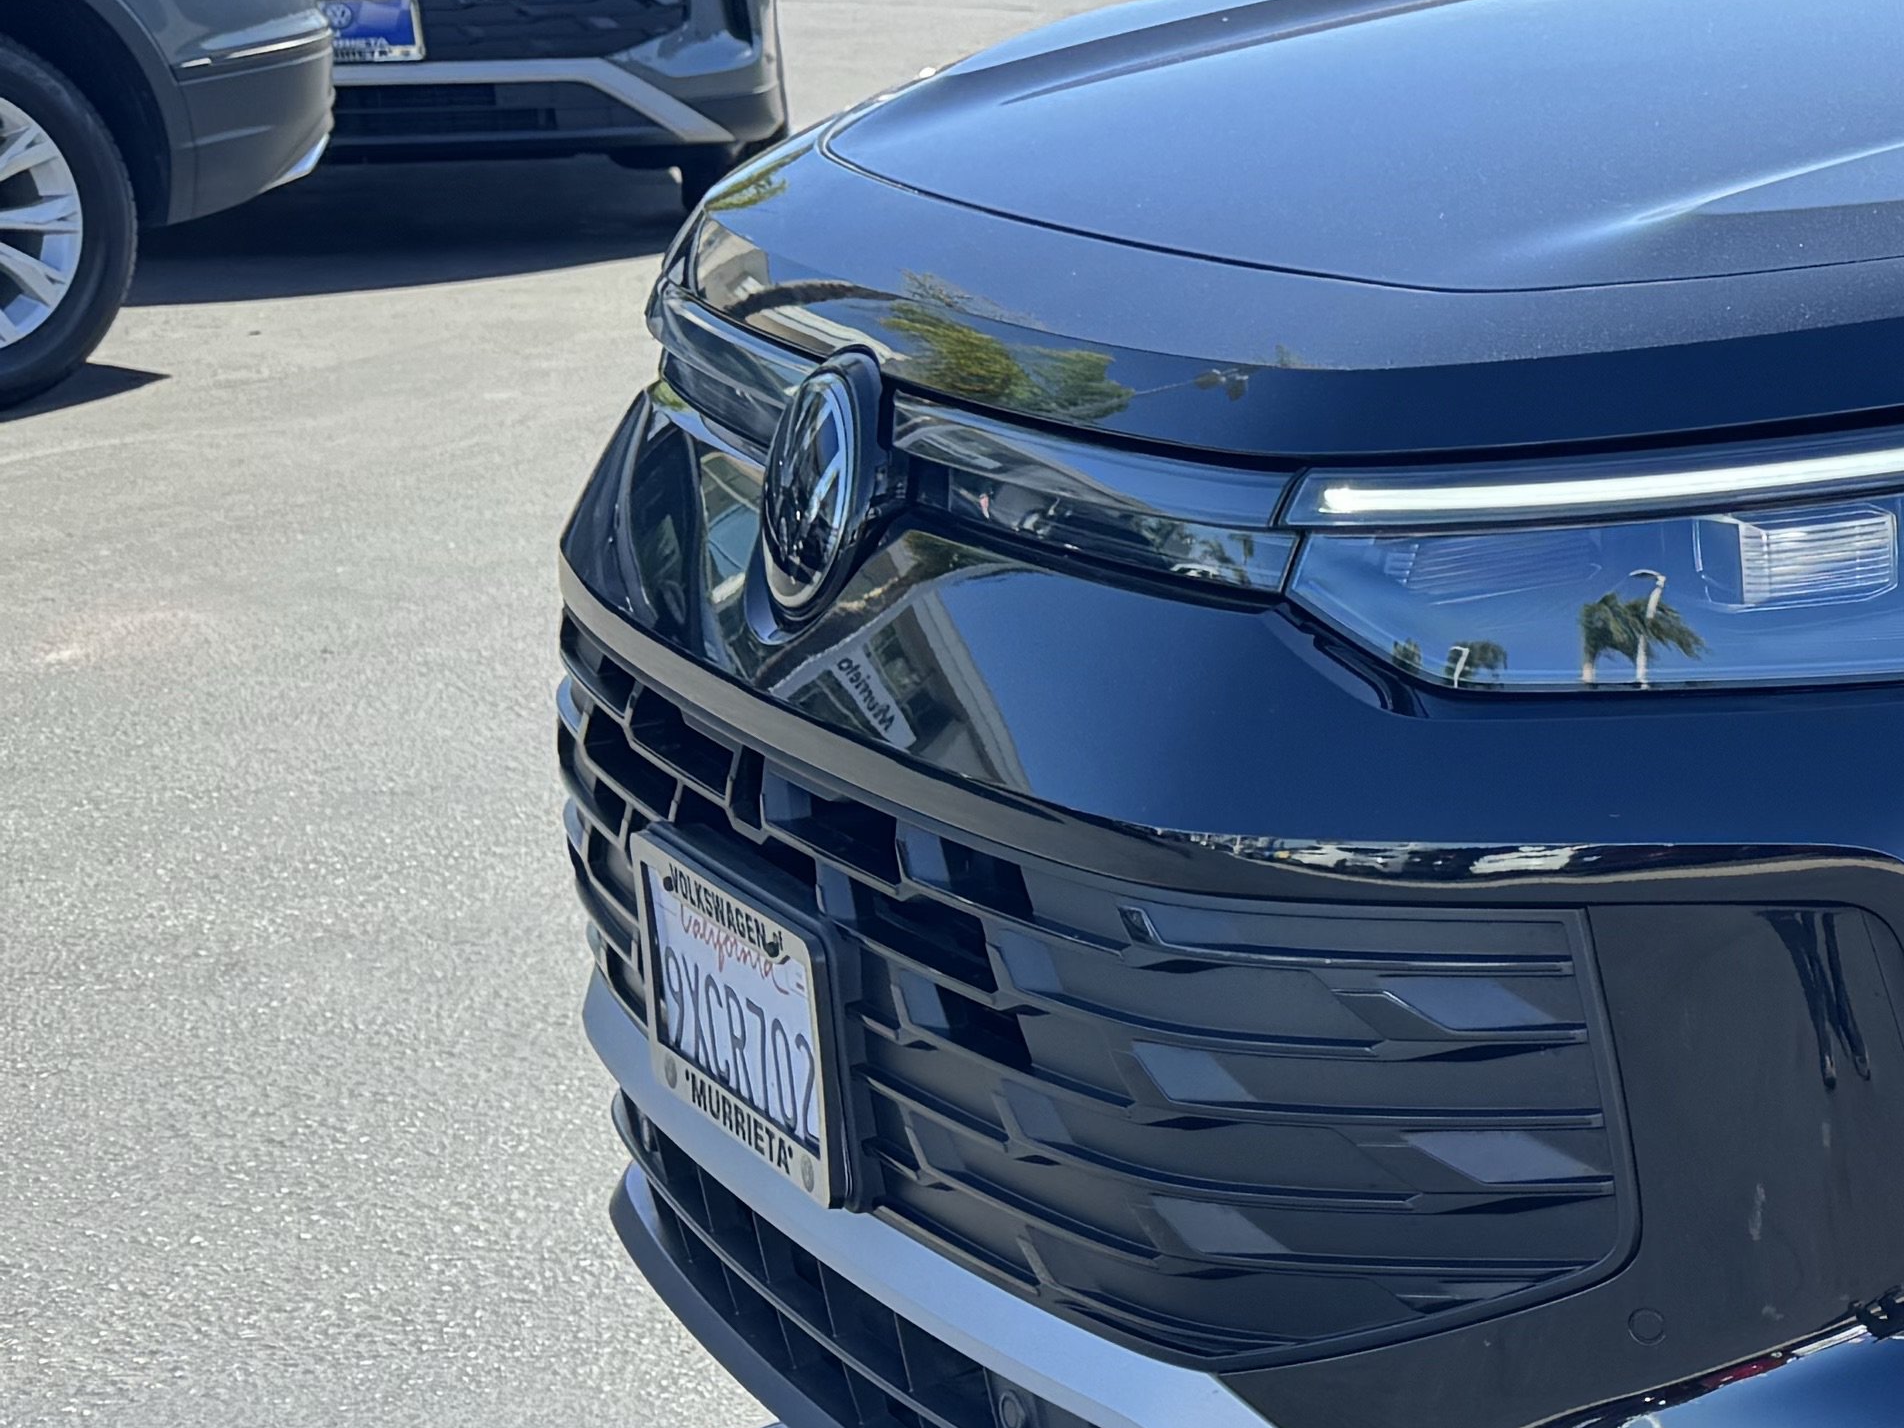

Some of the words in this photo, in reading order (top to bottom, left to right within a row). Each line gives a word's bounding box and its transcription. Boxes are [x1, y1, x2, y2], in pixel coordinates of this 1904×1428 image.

[669, 863, 768, 949] VOLKSWAGEN
[664, 946, 820, 1141] 9XCR702
[689, 1075, 791, 1176] MURRIETA
